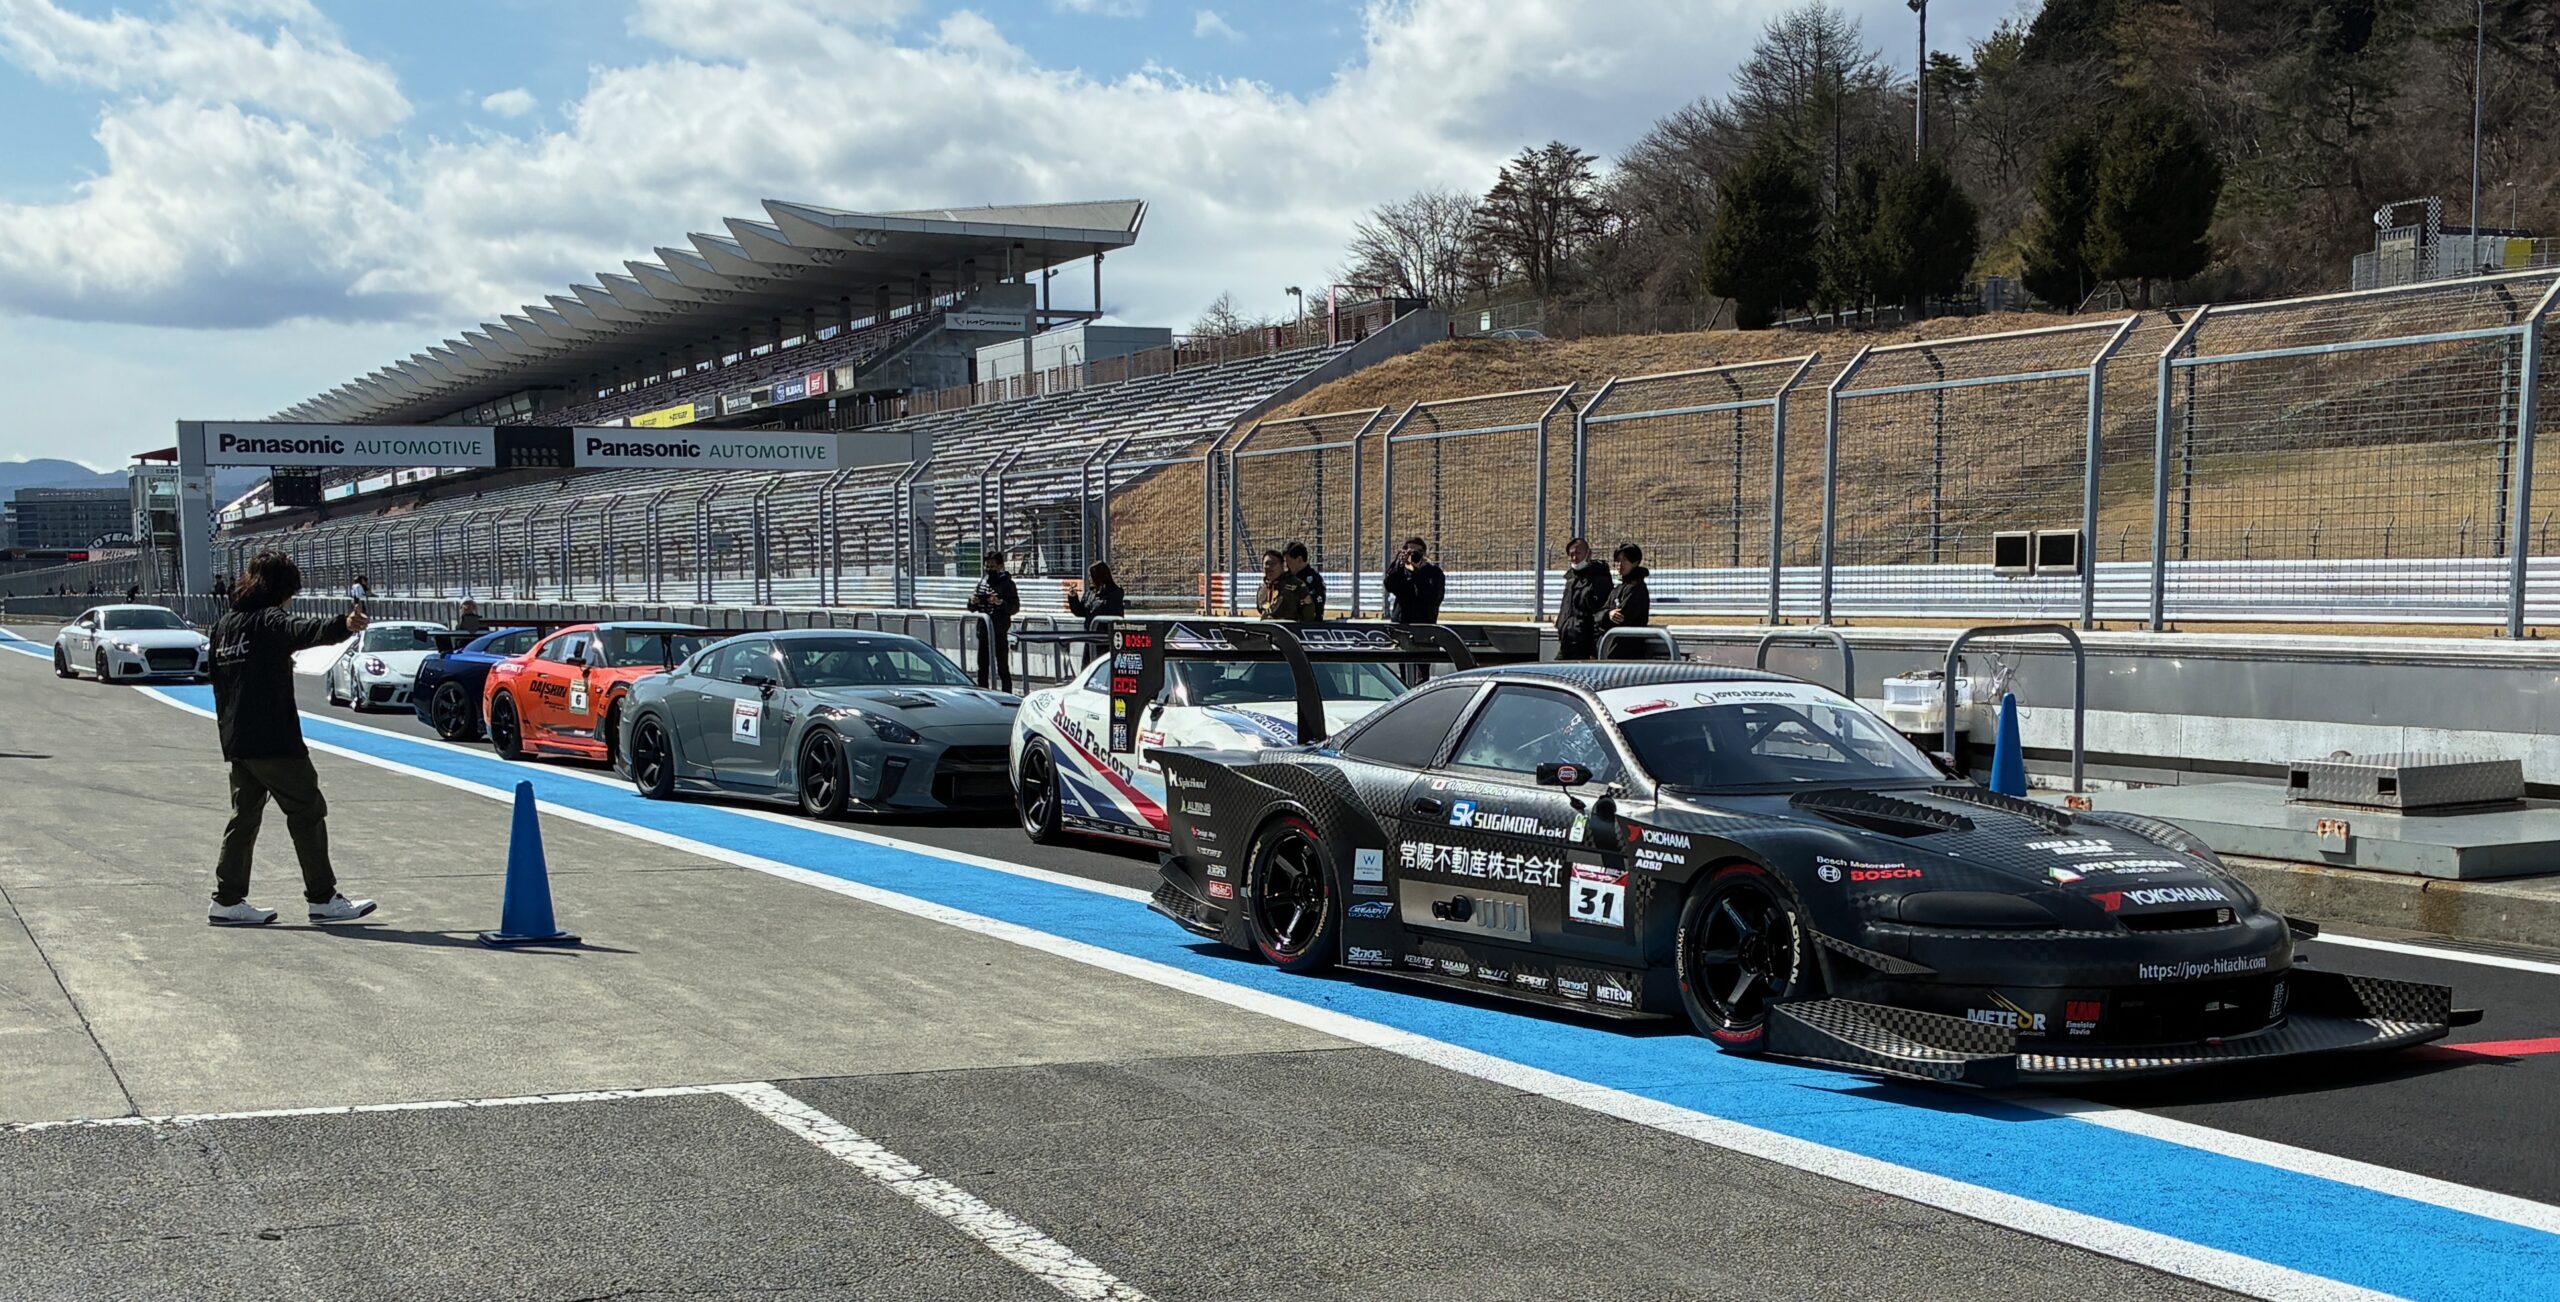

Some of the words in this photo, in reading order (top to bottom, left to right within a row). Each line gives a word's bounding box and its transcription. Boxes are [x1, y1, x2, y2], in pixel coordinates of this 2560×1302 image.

[219, 433, 345, 454] Panasonic
[353, 440, 482, 456] AUTOMOTIVE
[586, 437, 701, 458] Panasonic
[709, 444, 826, 460] AUTOMOTIVE
[1125, 634, 1152, 648] BOSCH
[741, 718, 751, 732] 4
[1053, 698, 1083, 745] Rush
[1083, 728, 1134, 785] Factory
[1641, 828, 1691, 850] YOKOHAMA
[1363, 855, 1376, 865] W
[1400, 840, 1563, 888] 常陽不動産株式会社
[1635, 848, 1685, 865] ADVAN
[1816, 855, 1848, 867] Bosch
[1850, 860, 1906, 870] Motorsport
[1850, 868, 1923, 881] BOSCH
[1577, 887, 1615, 919] 31
[2122, 886, 2231, 906] YOKOHAMA
[1787, 911, 1801, 985] ADVAN
[1477, 966, 1509, 979] Swift
[2139, 955, 2267, 980] https://joyo-hitachi.com
[1516, 973, 1549, 987] SPIRIT
[1596, 985, 1633, 1003] METEOR
[1967, 1007, 2046, 1031] METEOR
